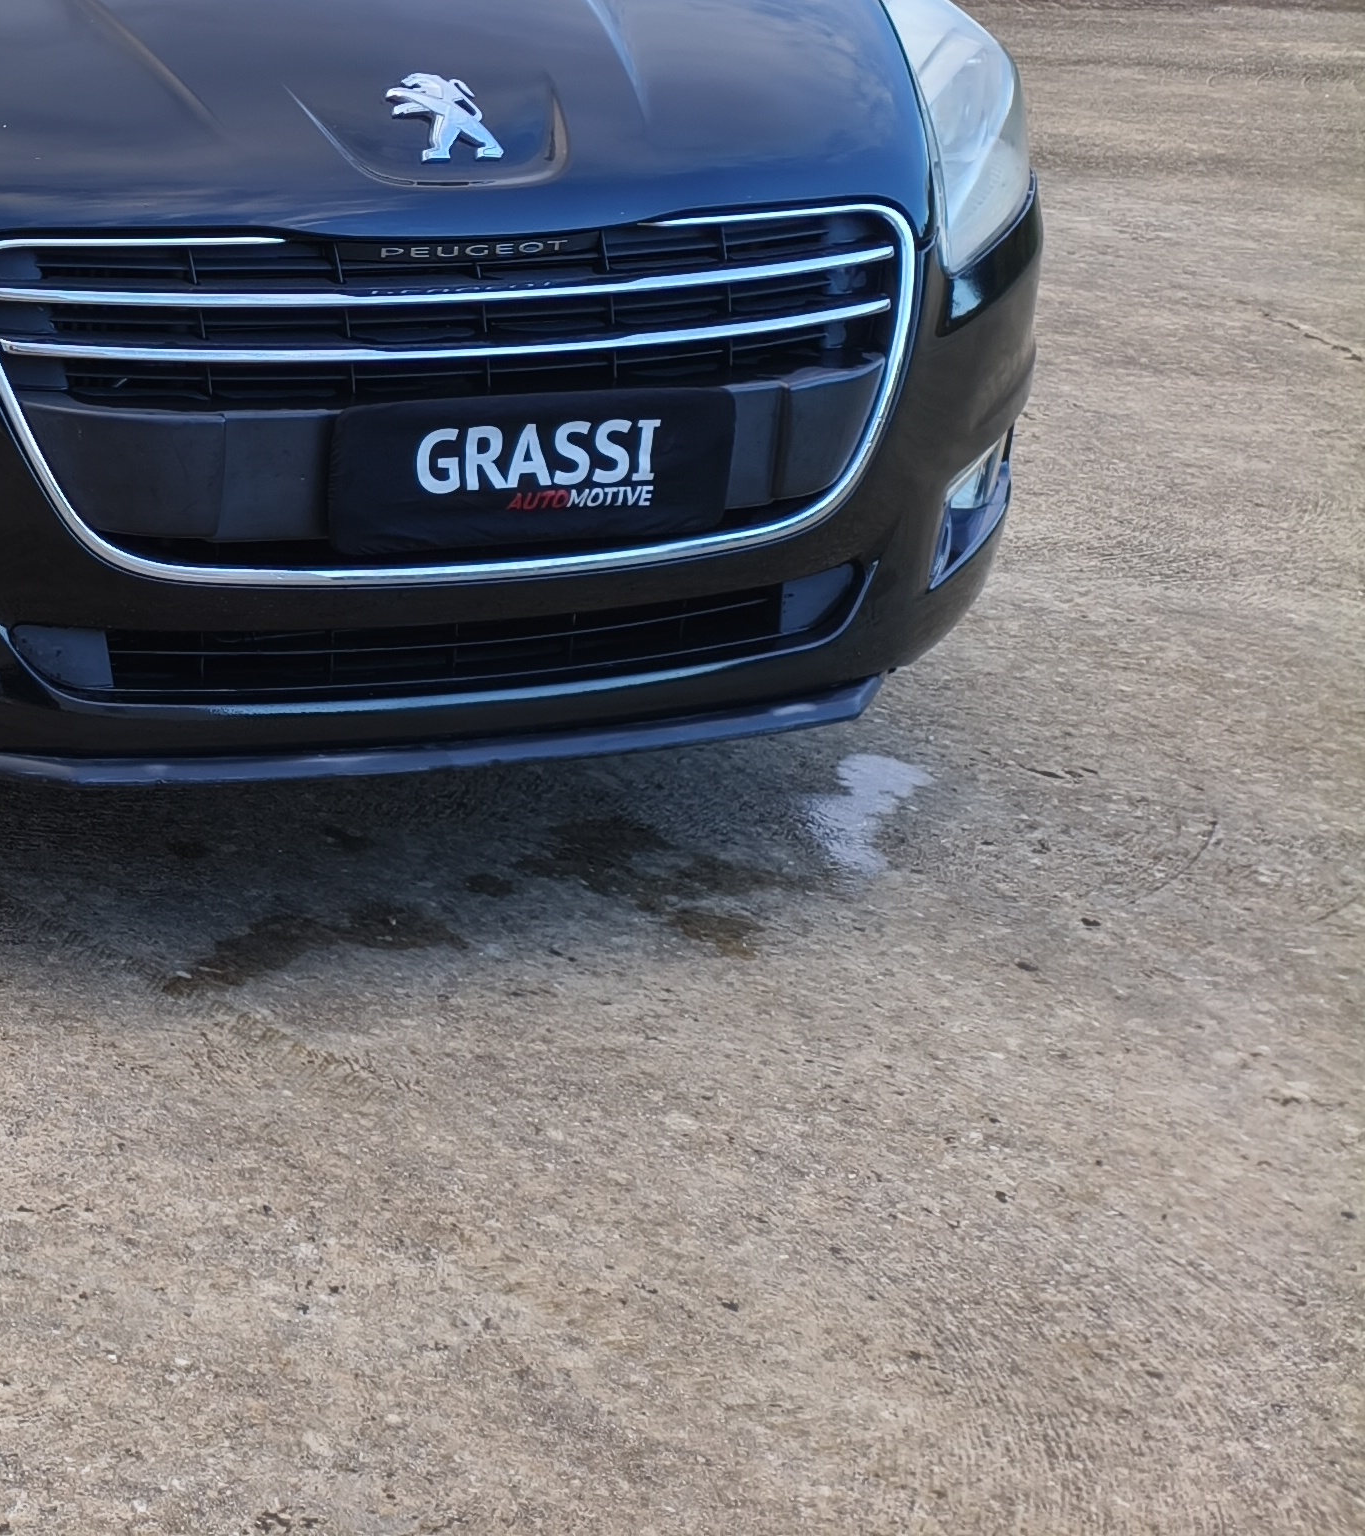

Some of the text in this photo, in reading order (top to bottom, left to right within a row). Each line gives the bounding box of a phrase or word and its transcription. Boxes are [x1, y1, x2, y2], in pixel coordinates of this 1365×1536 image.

[379, 239, 569, 259] PEUGEOT
[416, 419, 662, 494] GRASSI
[506, 484, 654, 510] AUTOMOTIVE
